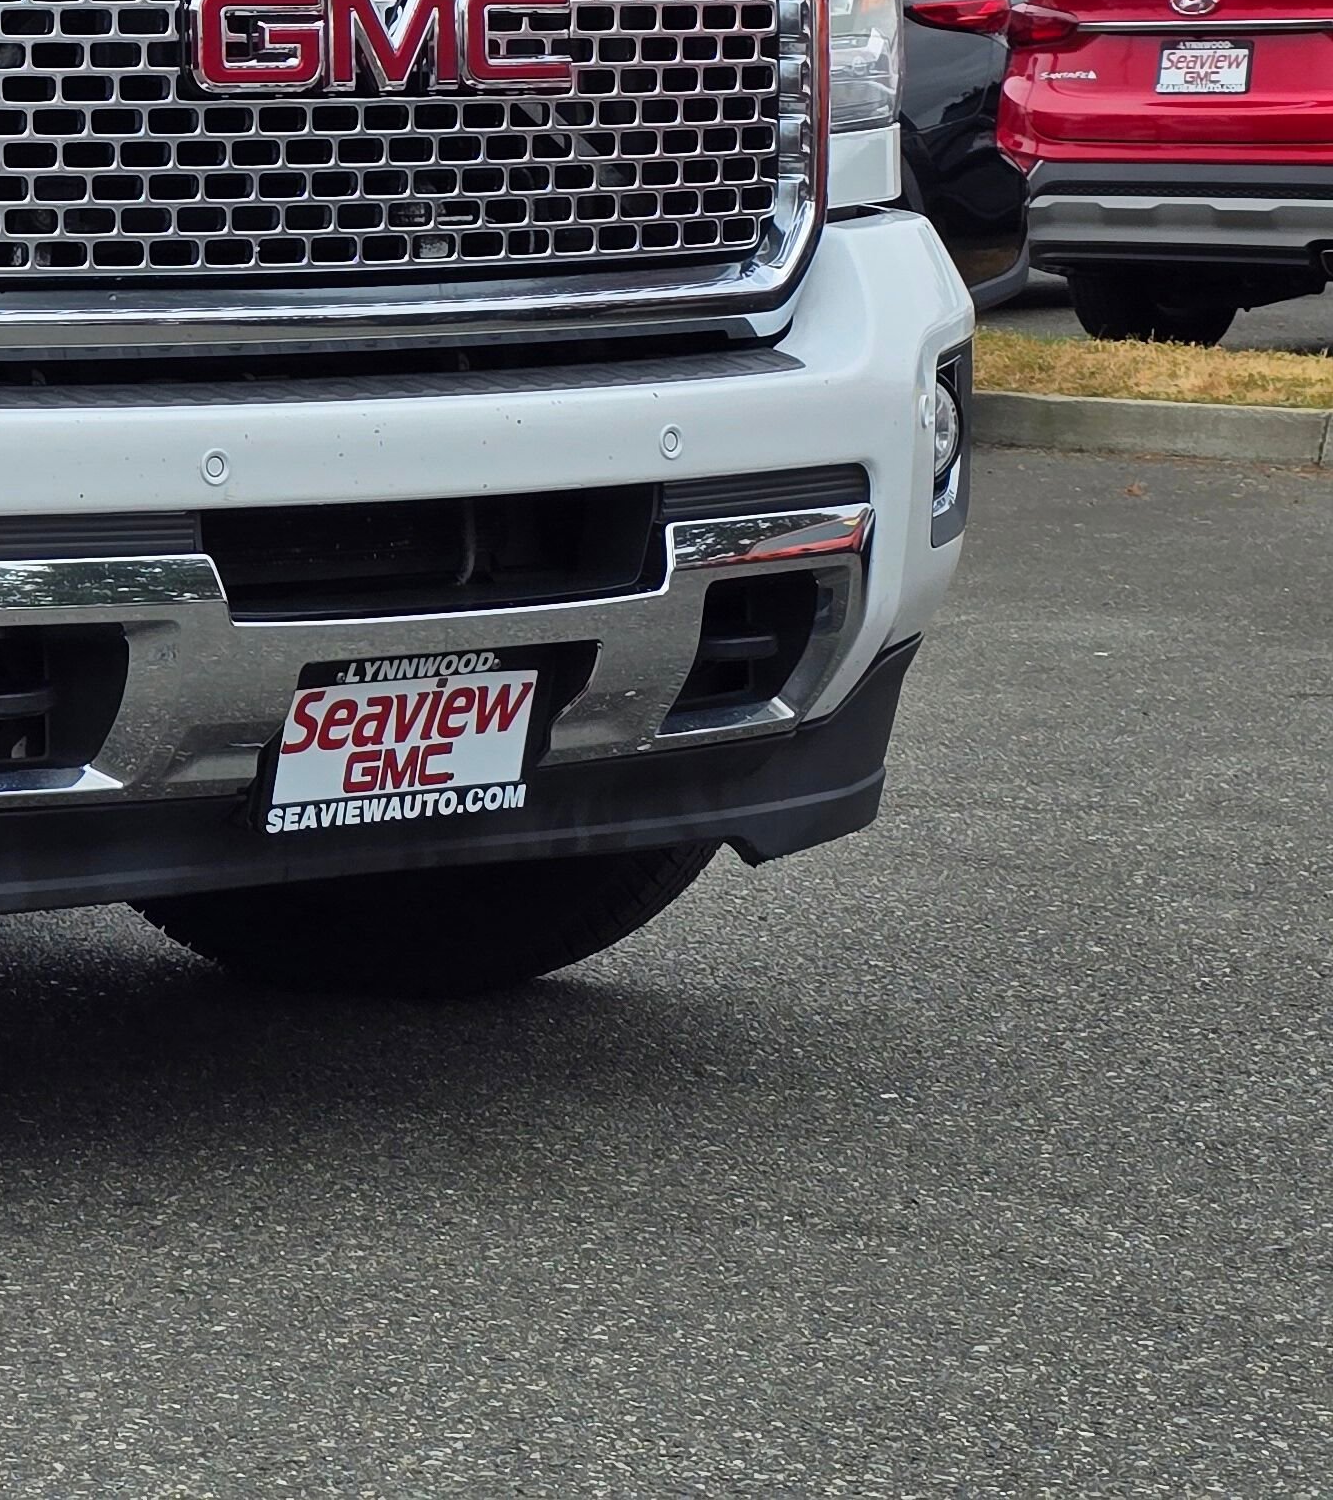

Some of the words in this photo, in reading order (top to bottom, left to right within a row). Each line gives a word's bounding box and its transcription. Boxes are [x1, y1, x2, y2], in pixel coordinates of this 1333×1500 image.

[1161, 50, 1248, 70] Seaview
[1183, 71, 1221, 84] GMC
[345, 652, 495, 683] LYNNWOOD
[281, 677, 534, 754] Seaview
[343, 742, 454, 793] GMC
[266, 784, 527, 834] SEAVIEWAUTO.COM
